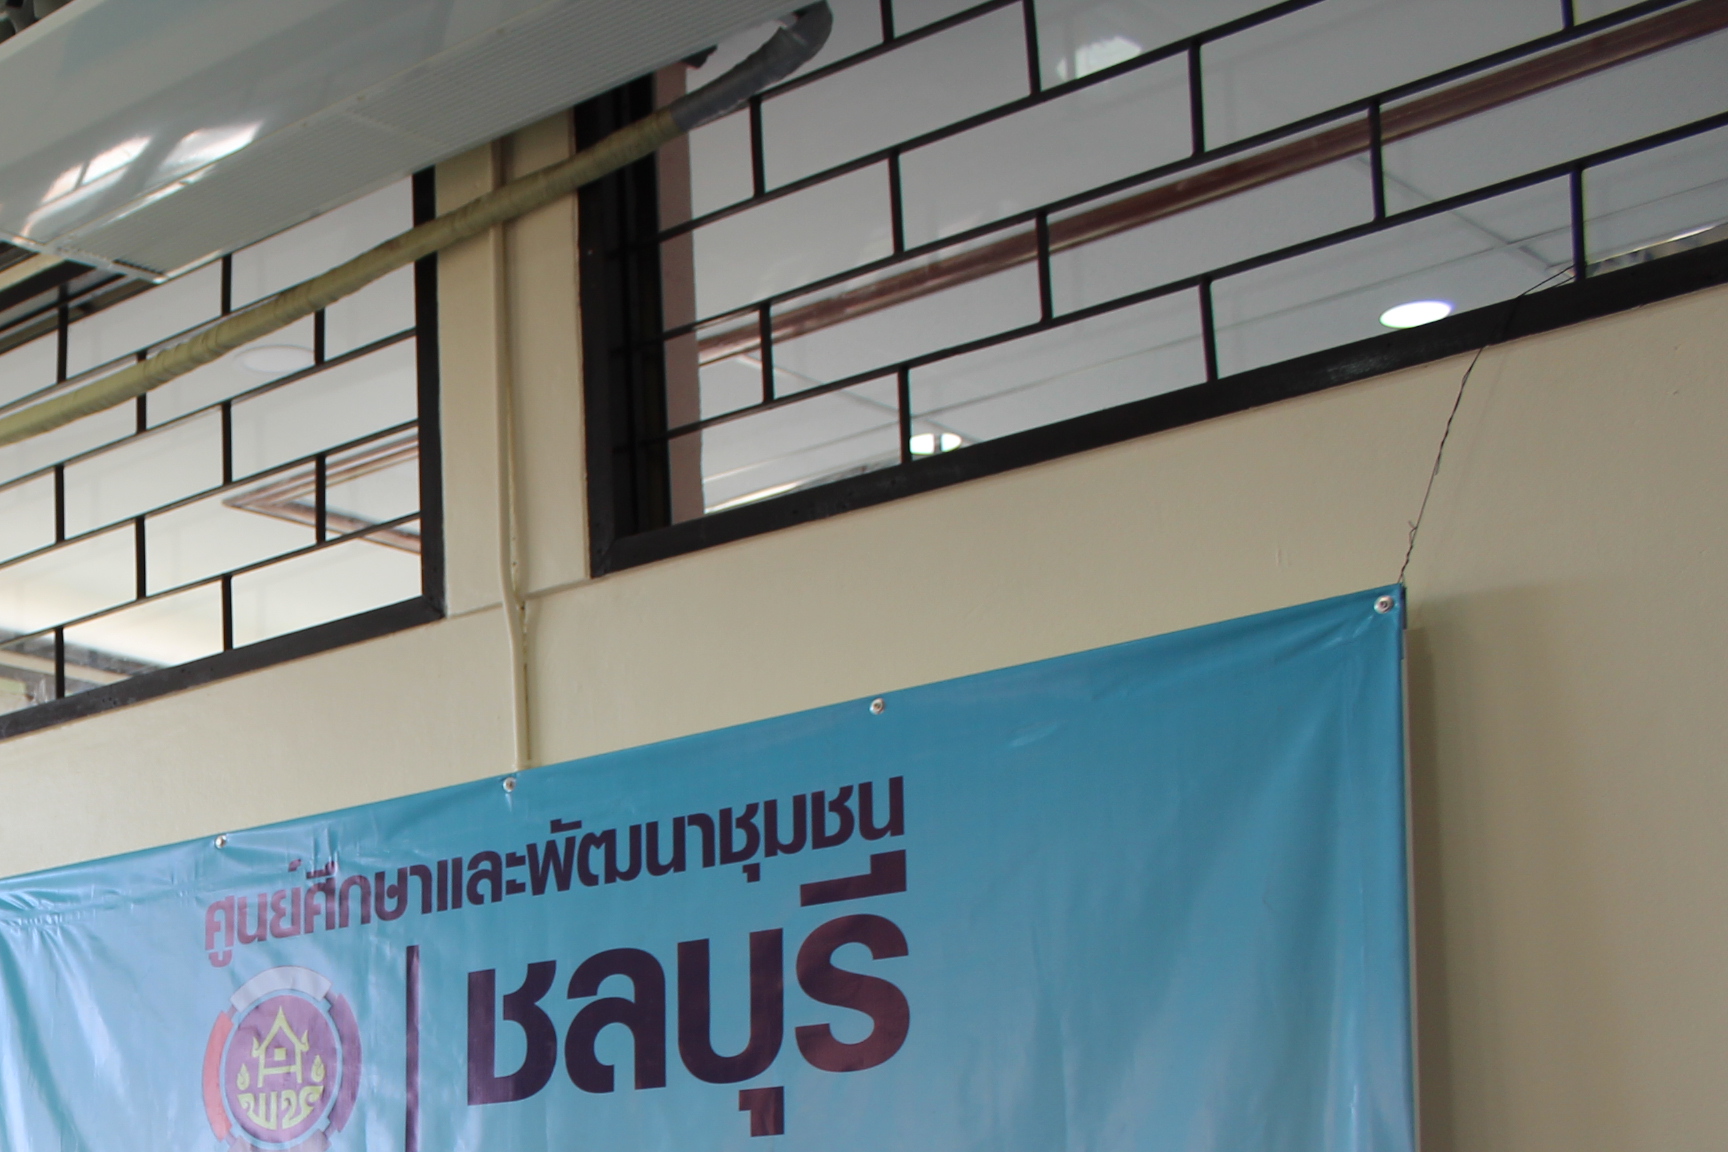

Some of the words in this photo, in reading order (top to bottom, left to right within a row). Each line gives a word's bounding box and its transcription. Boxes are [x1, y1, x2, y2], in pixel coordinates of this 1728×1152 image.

[206, 775, 905, 967] ศูนย์ศึกษาและพัฒนาชุมชน
[467, 850, 911, 1137] ชลบุรี
